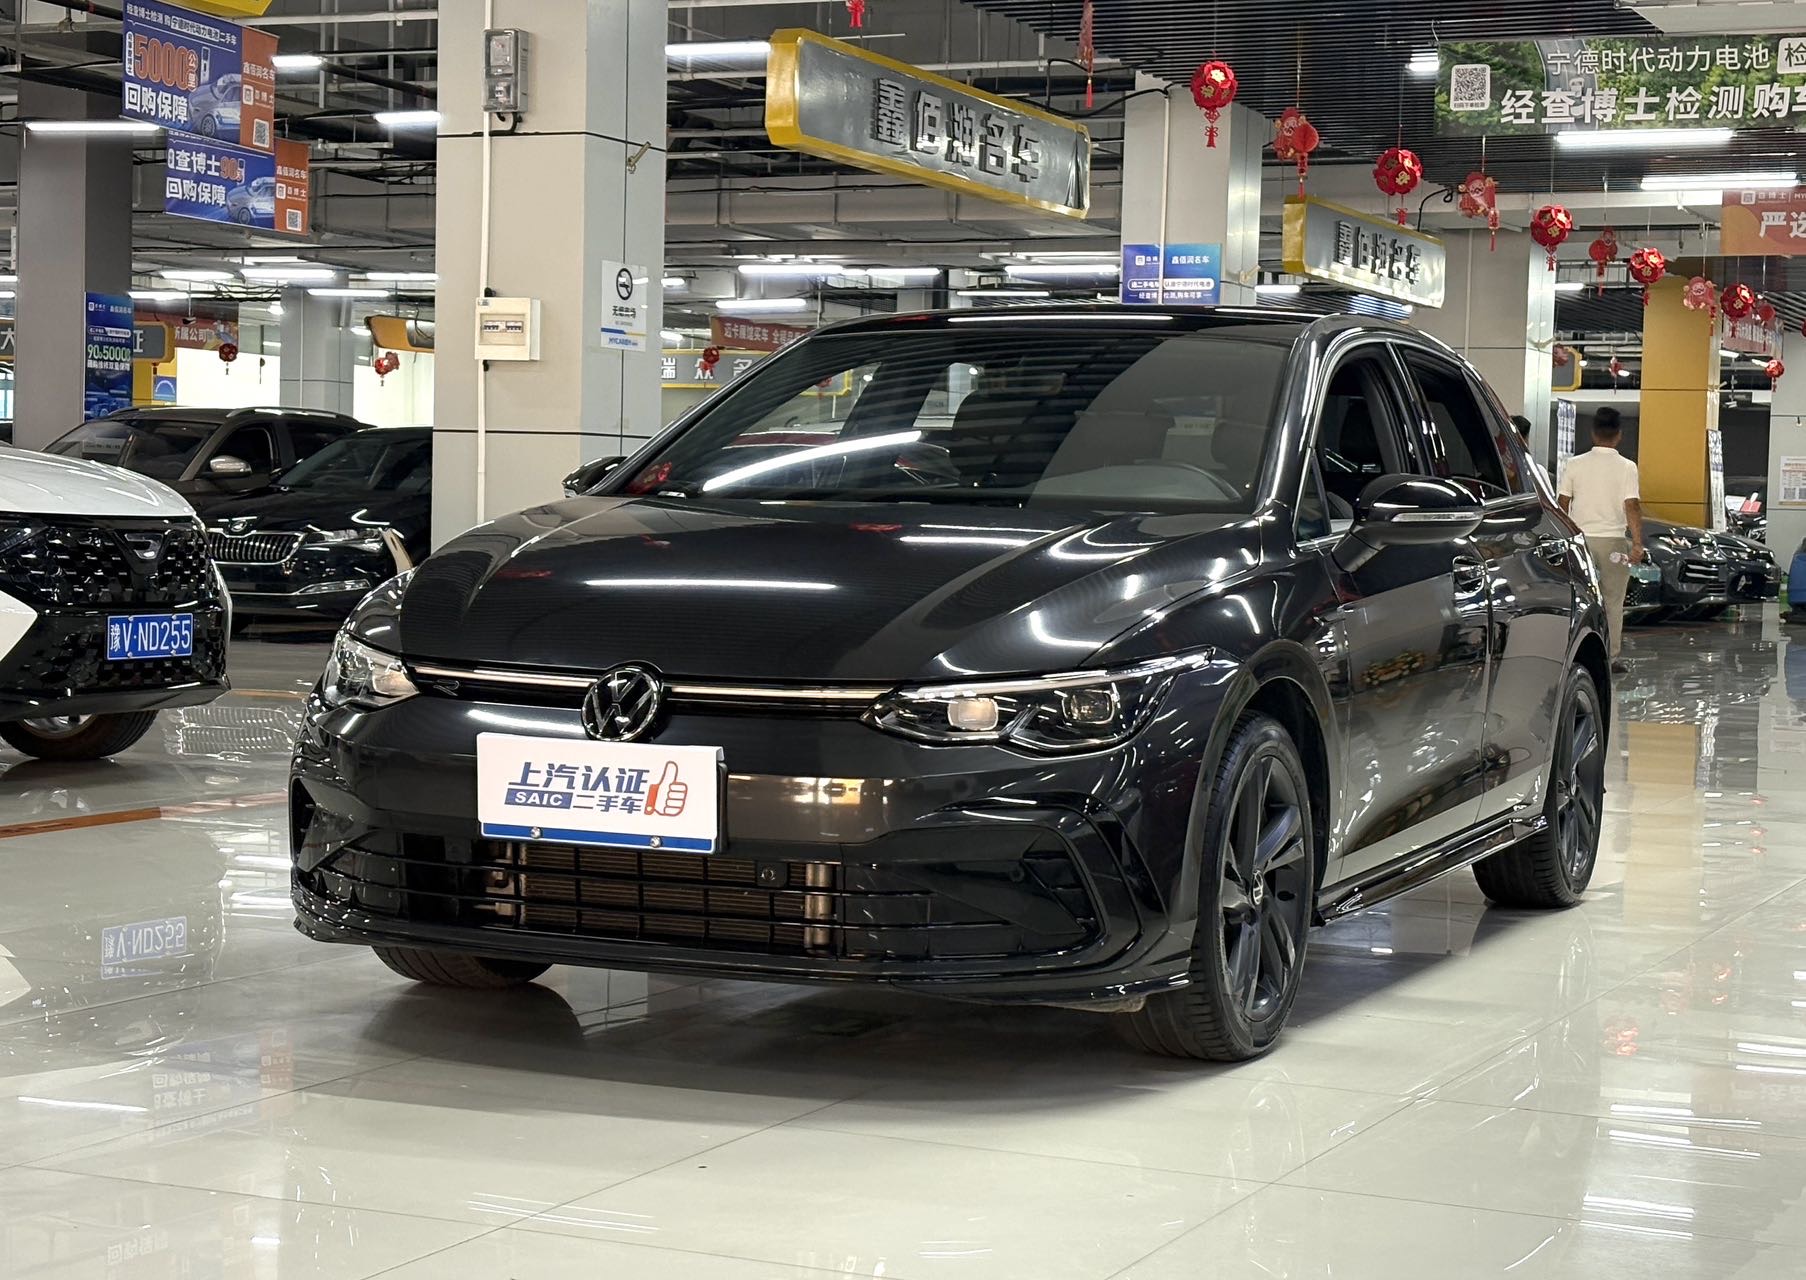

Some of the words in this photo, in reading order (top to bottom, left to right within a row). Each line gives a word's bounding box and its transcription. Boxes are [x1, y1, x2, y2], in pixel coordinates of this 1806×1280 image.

[1547, 44, 1771, 76] 宁德时代动力电池
[125, 81, 188, 124] 回购保障
[166, 177, 226, 207] 回购保障
[508, 761, 649, 795] 上汽认证
[515, 791, 563, 806] SAIC
[573, 795, 644, 814] 二手车
